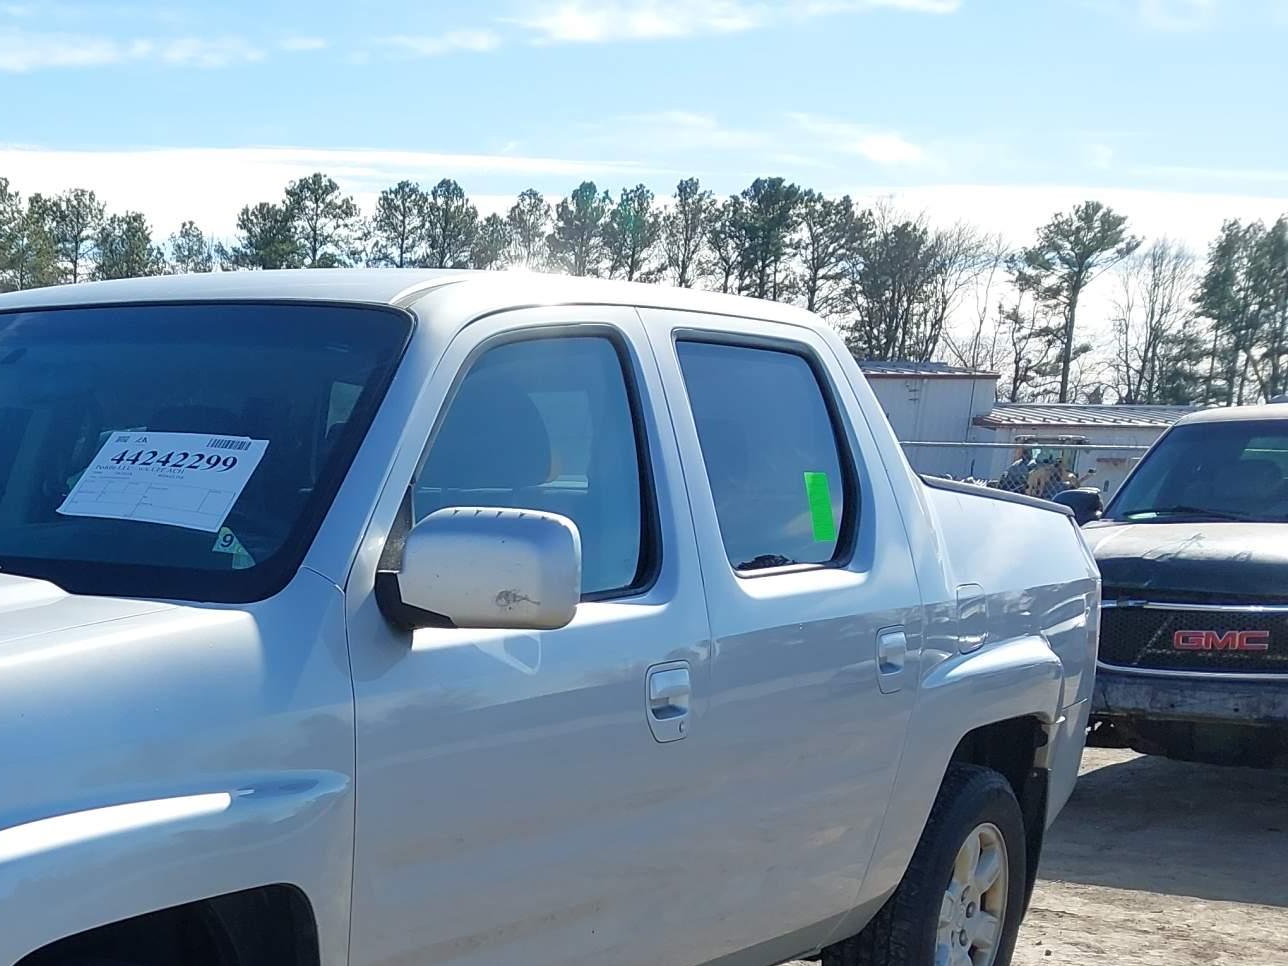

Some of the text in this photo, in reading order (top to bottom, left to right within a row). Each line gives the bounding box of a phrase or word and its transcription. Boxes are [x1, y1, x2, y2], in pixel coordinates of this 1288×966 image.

[111, 450, 238, 473] 44242299
[220, 533, 235, 548] 9
[1174, 630, 1270, 650] GMC
